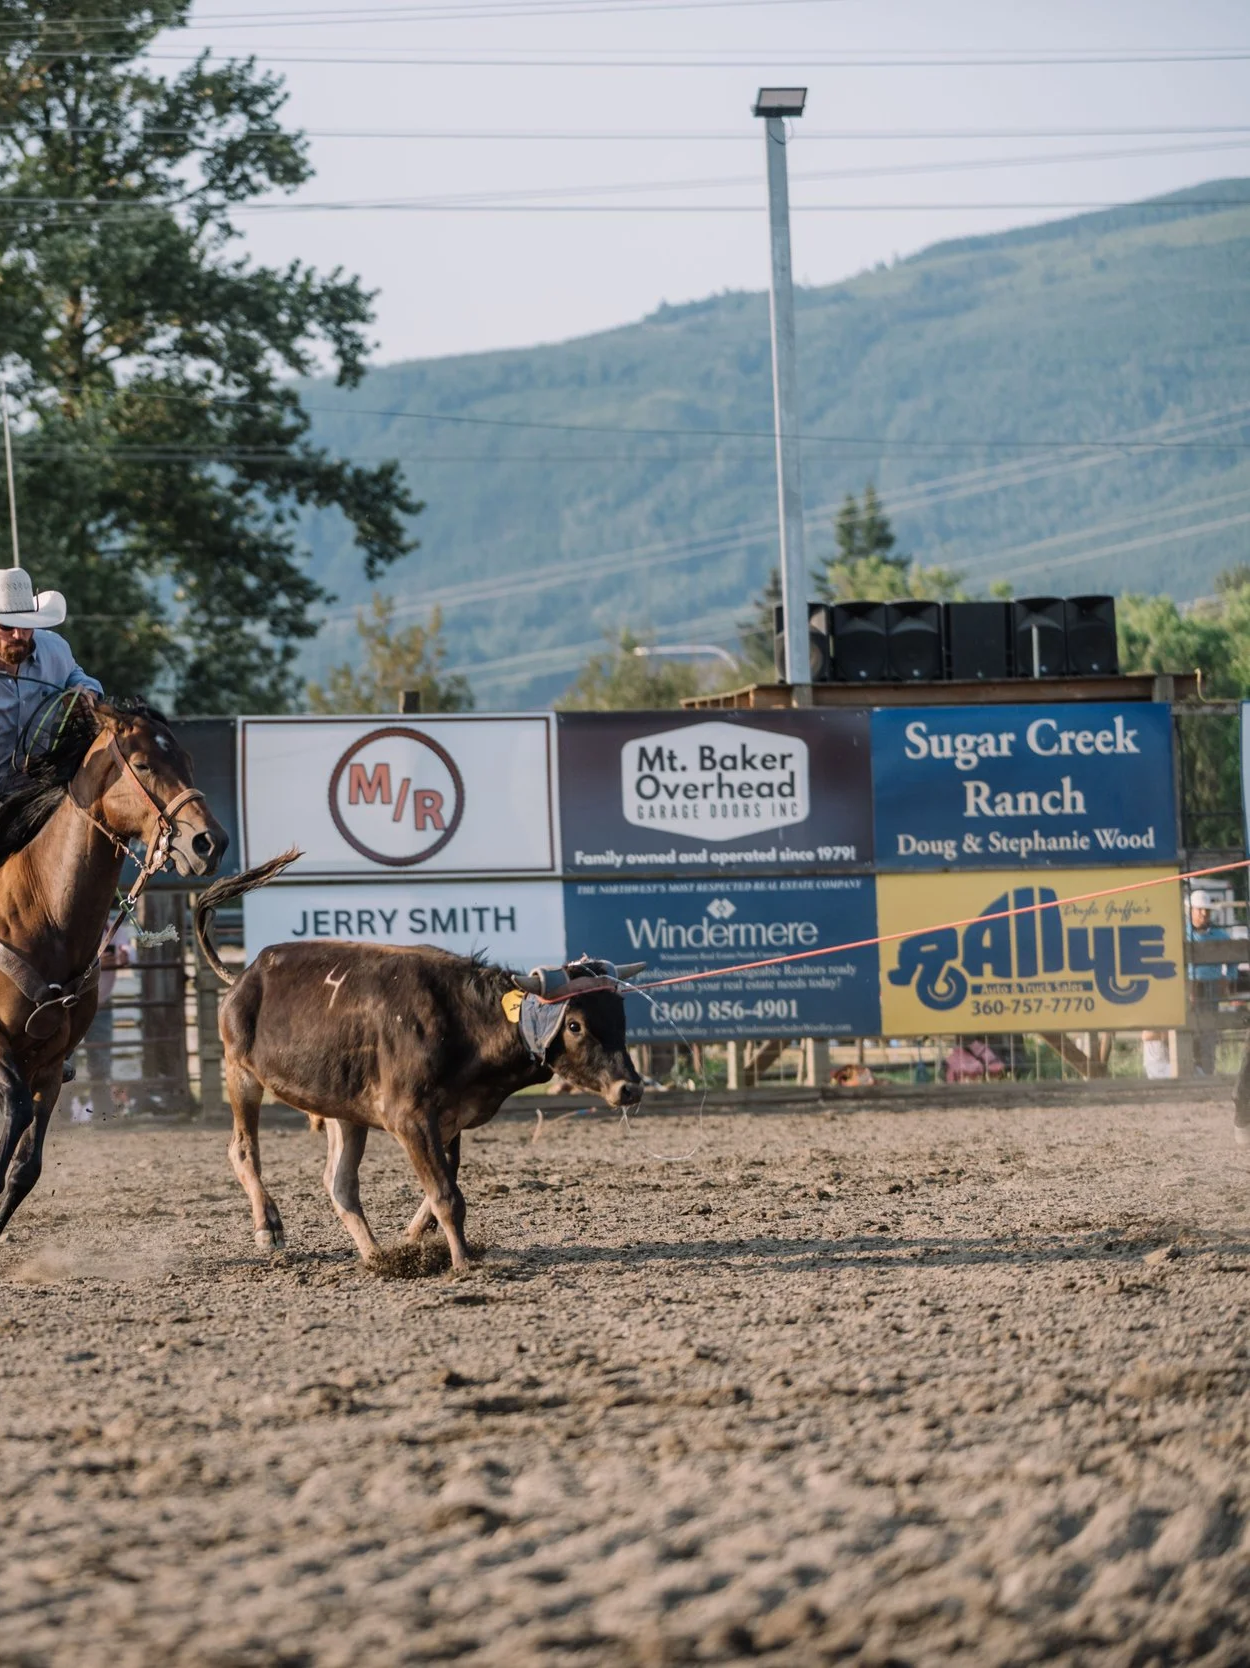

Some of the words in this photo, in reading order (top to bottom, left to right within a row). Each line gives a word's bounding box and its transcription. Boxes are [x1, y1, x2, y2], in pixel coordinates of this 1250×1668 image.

[905, 721, 1015, 770] Sugar
[1026, 715, 1141, 757] Creek
[637, 746, 687, 772] Mt.
[699, 744, 793, 771] Baker
[348, 763, 447, 831] M/R
[635, 771, 795, 800] Overhead
[963, 776, 1086, 817] Ranch
[637, 804, 699, 820] GARAGE
[710, 803, 762, 818] DOORS
[772, 802, 798, 817] INC
[574, 851, 623, 868] Family
[626, 850, 676, 864] owned
[679, 848, 708, 863] and
[710, 848, 777, 866] operated
[779, 847, 815, 861] since
[817, 846, 857, 861] 1979!
[897, 834, 957, 861] Doug
[962, 833, 983, 853] &
[988, 831, 1090, 858] Stephanie
[1093, 827, 1155, 849] Wood
[577, 884, 596, 895] THE
[668, 882, 694, 893] MOST
[816, 879, 862, 890] COMPANY
[292, 910, 398, 937] JERRY
[409, 907, 516, 934] SMITH
[625, 916, 819, 949] Windermere
[650, 1000, 703, 1024] (360)
[708, 998, 799, 1020] 856-4901
[972, 996, 1095, 1016] 360-757-7770
